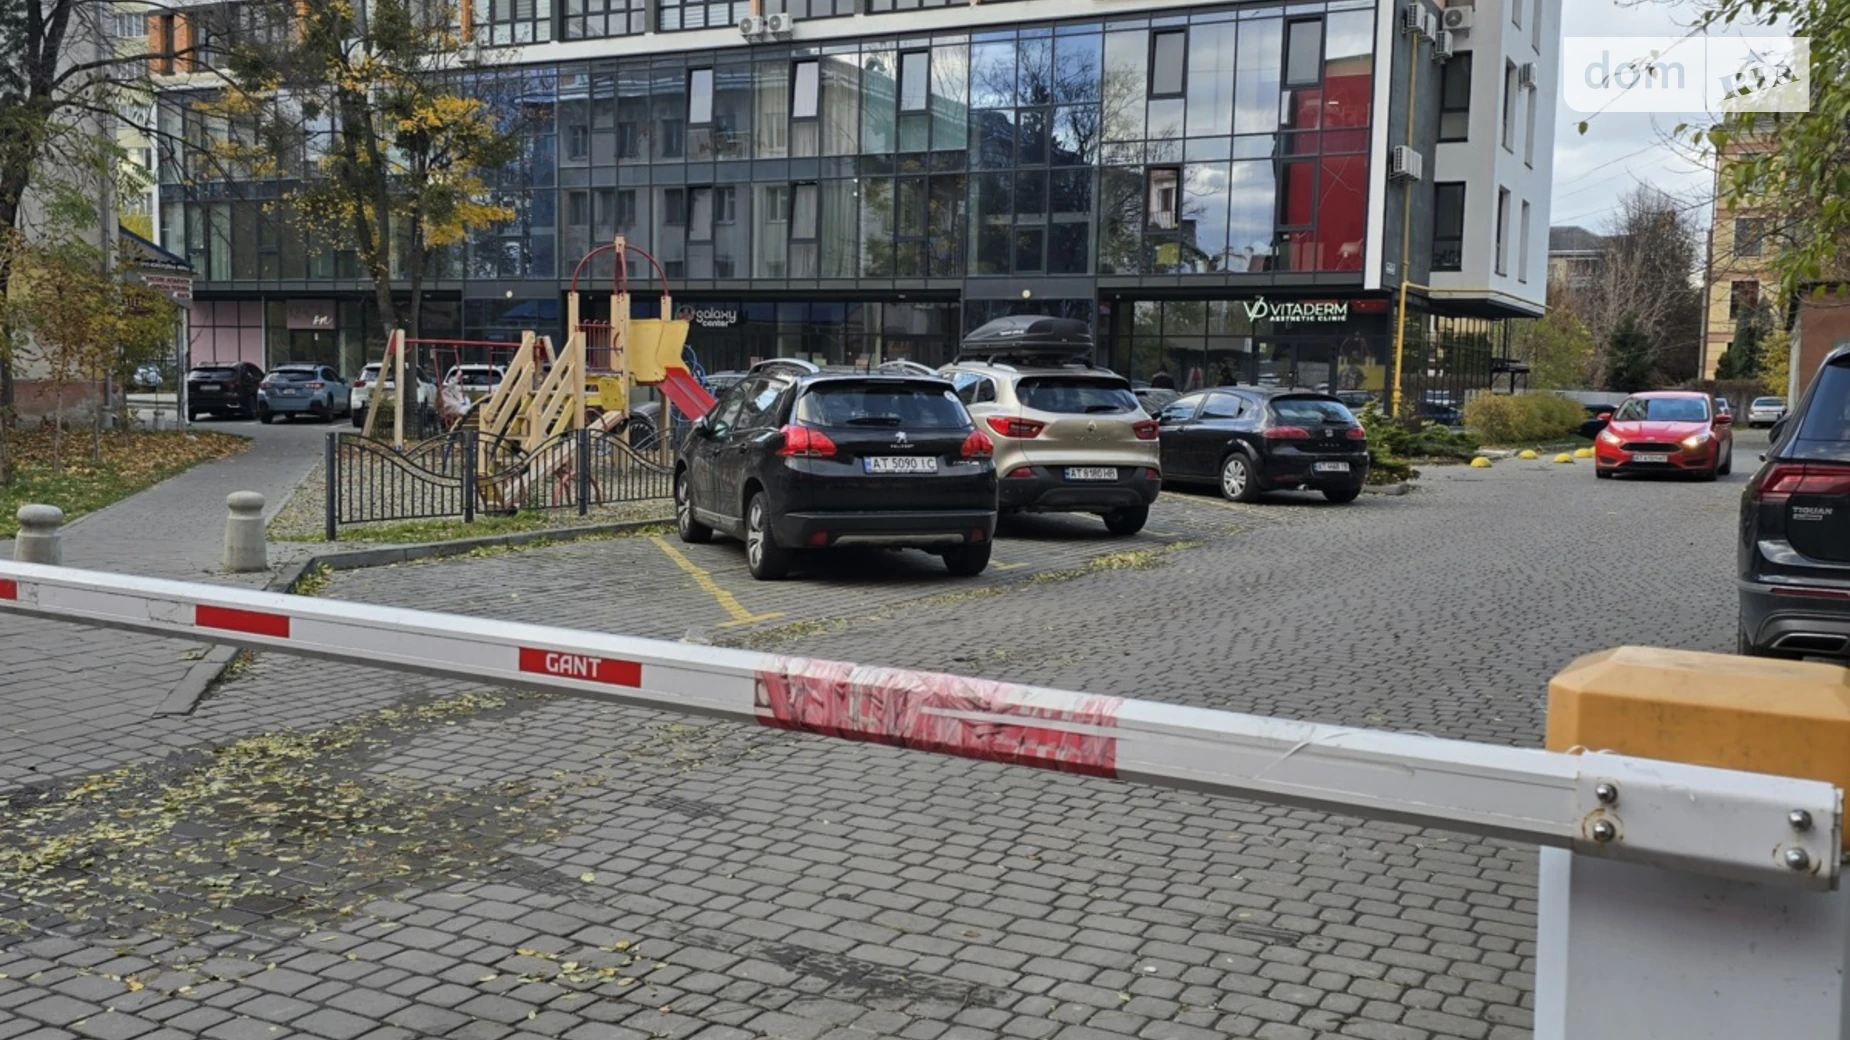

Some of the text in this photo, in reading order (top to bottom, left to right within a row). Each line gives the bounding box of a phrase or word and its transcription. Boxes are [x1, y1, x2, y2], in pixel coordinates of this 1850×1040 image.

[696, 306, 737, 323] galaxy
[1269, 302, 1348, 316] VITADERM
[873, 457, 936, 470] AT 5090 IC
[1070, 468, 1082, 478] AT
[545, 652, 602, 678] GANT
